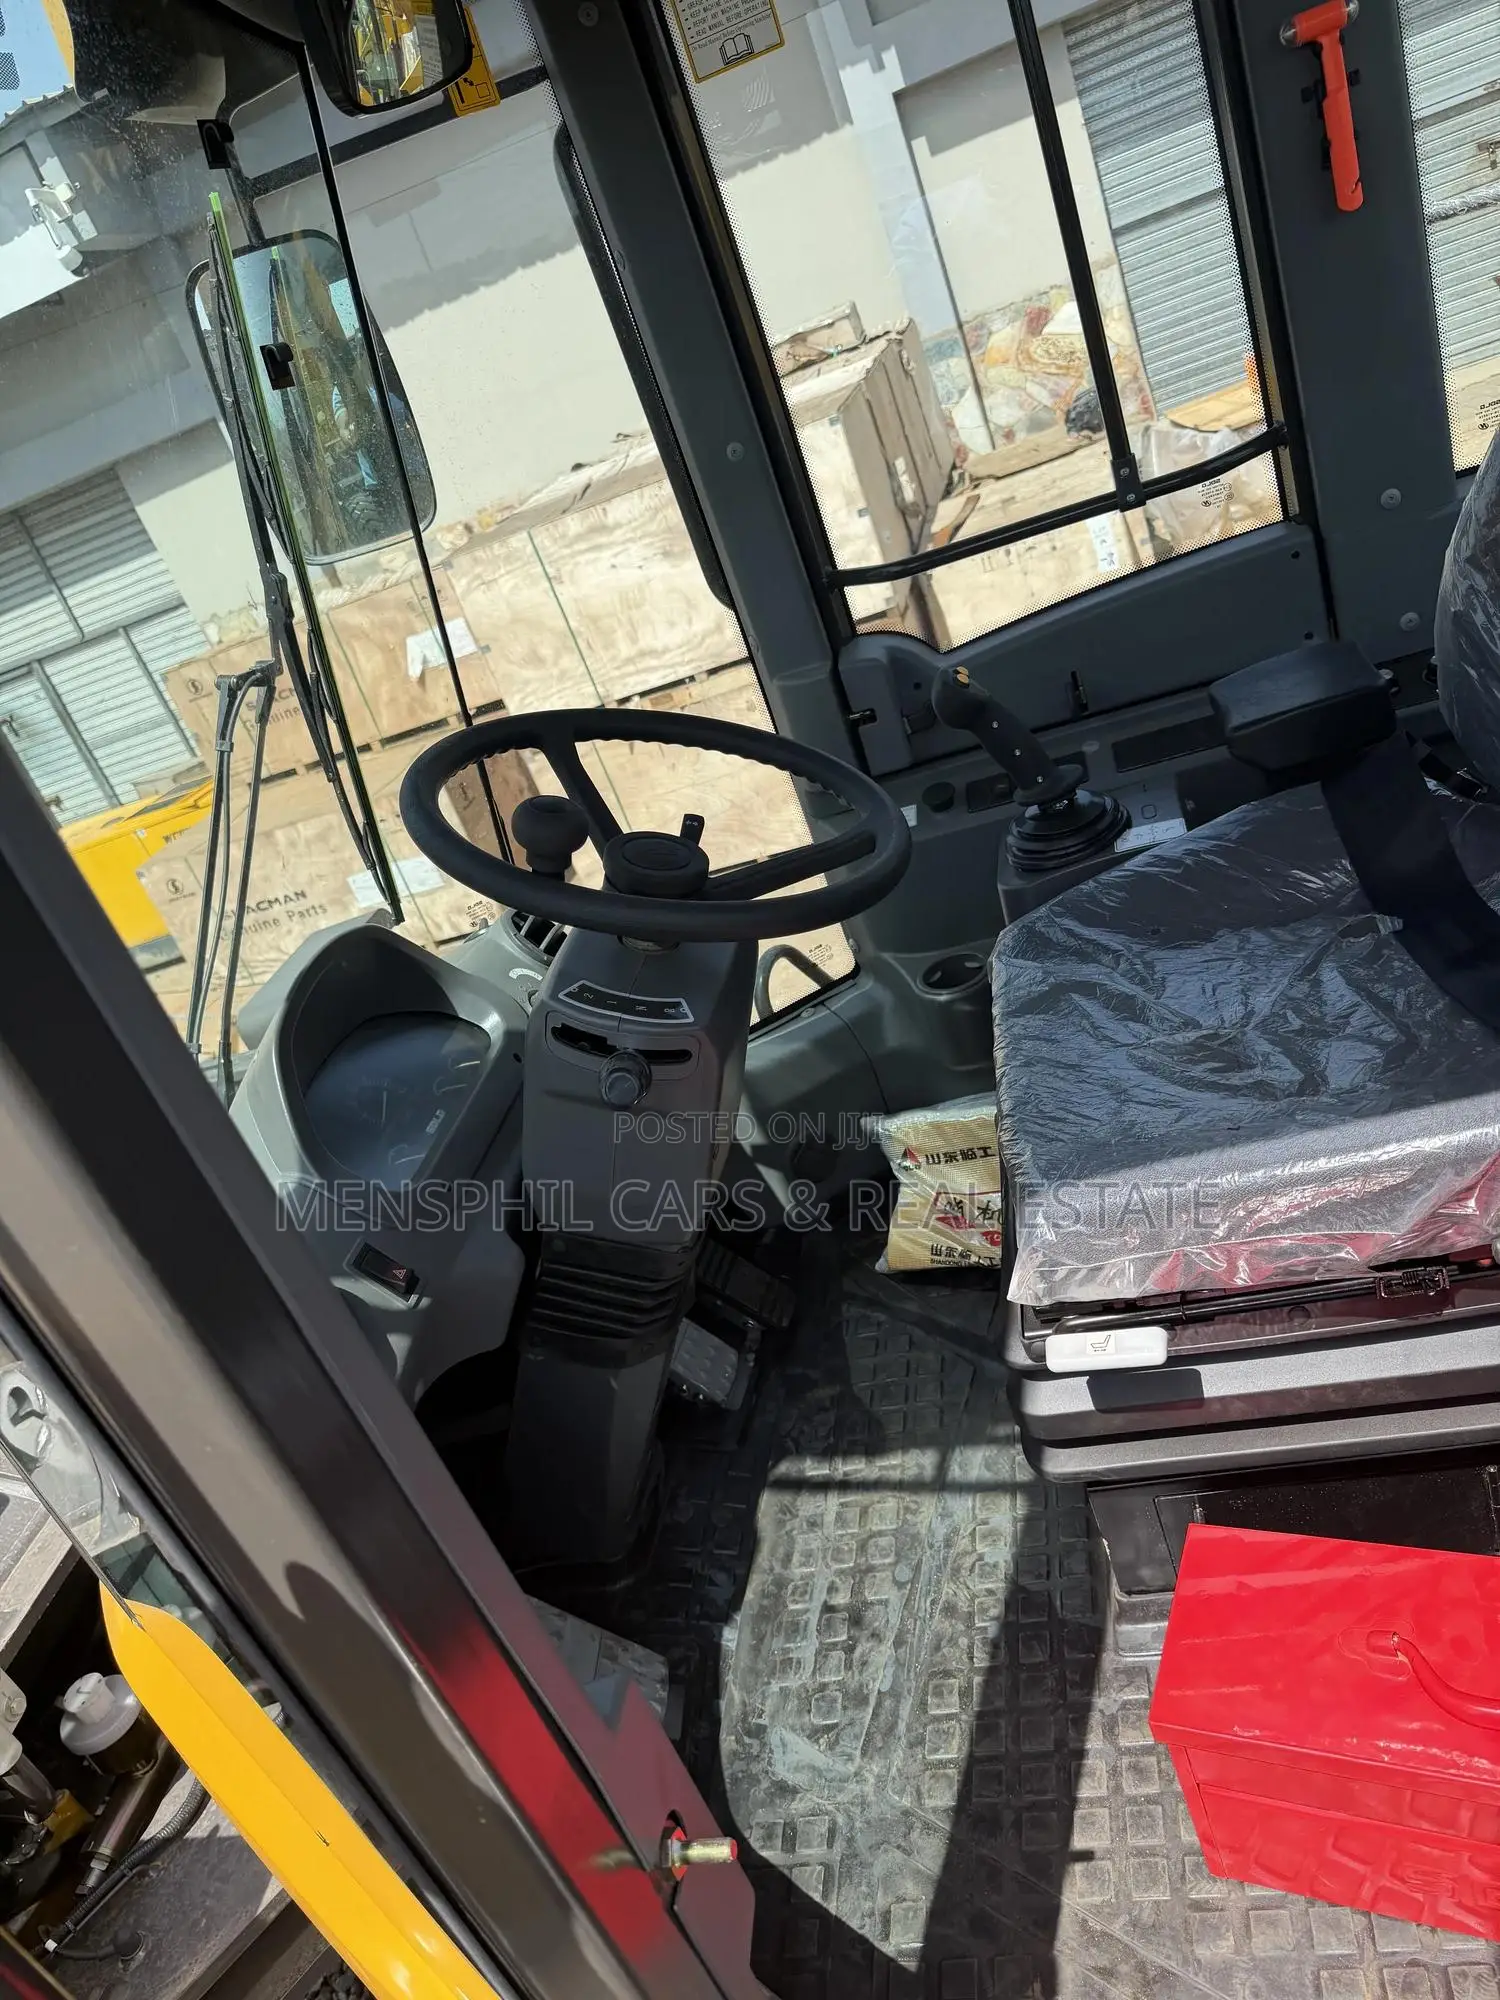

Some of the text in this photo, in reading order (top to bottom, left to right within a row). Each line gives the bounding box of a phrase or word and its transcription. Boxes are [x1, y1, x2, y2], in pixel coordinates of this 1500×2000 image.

[690, 8, 701, 18] KEEP
[693, 15, 708, 28] REPORT
[695, 27, 707, 37] READ
[708, 20, 725, 31] MANUAL
[725, 11, 743, 24] BEFORE
[285, 902, 329, 923] Parts
[925, 1145, 997, 1166] 山东临工
